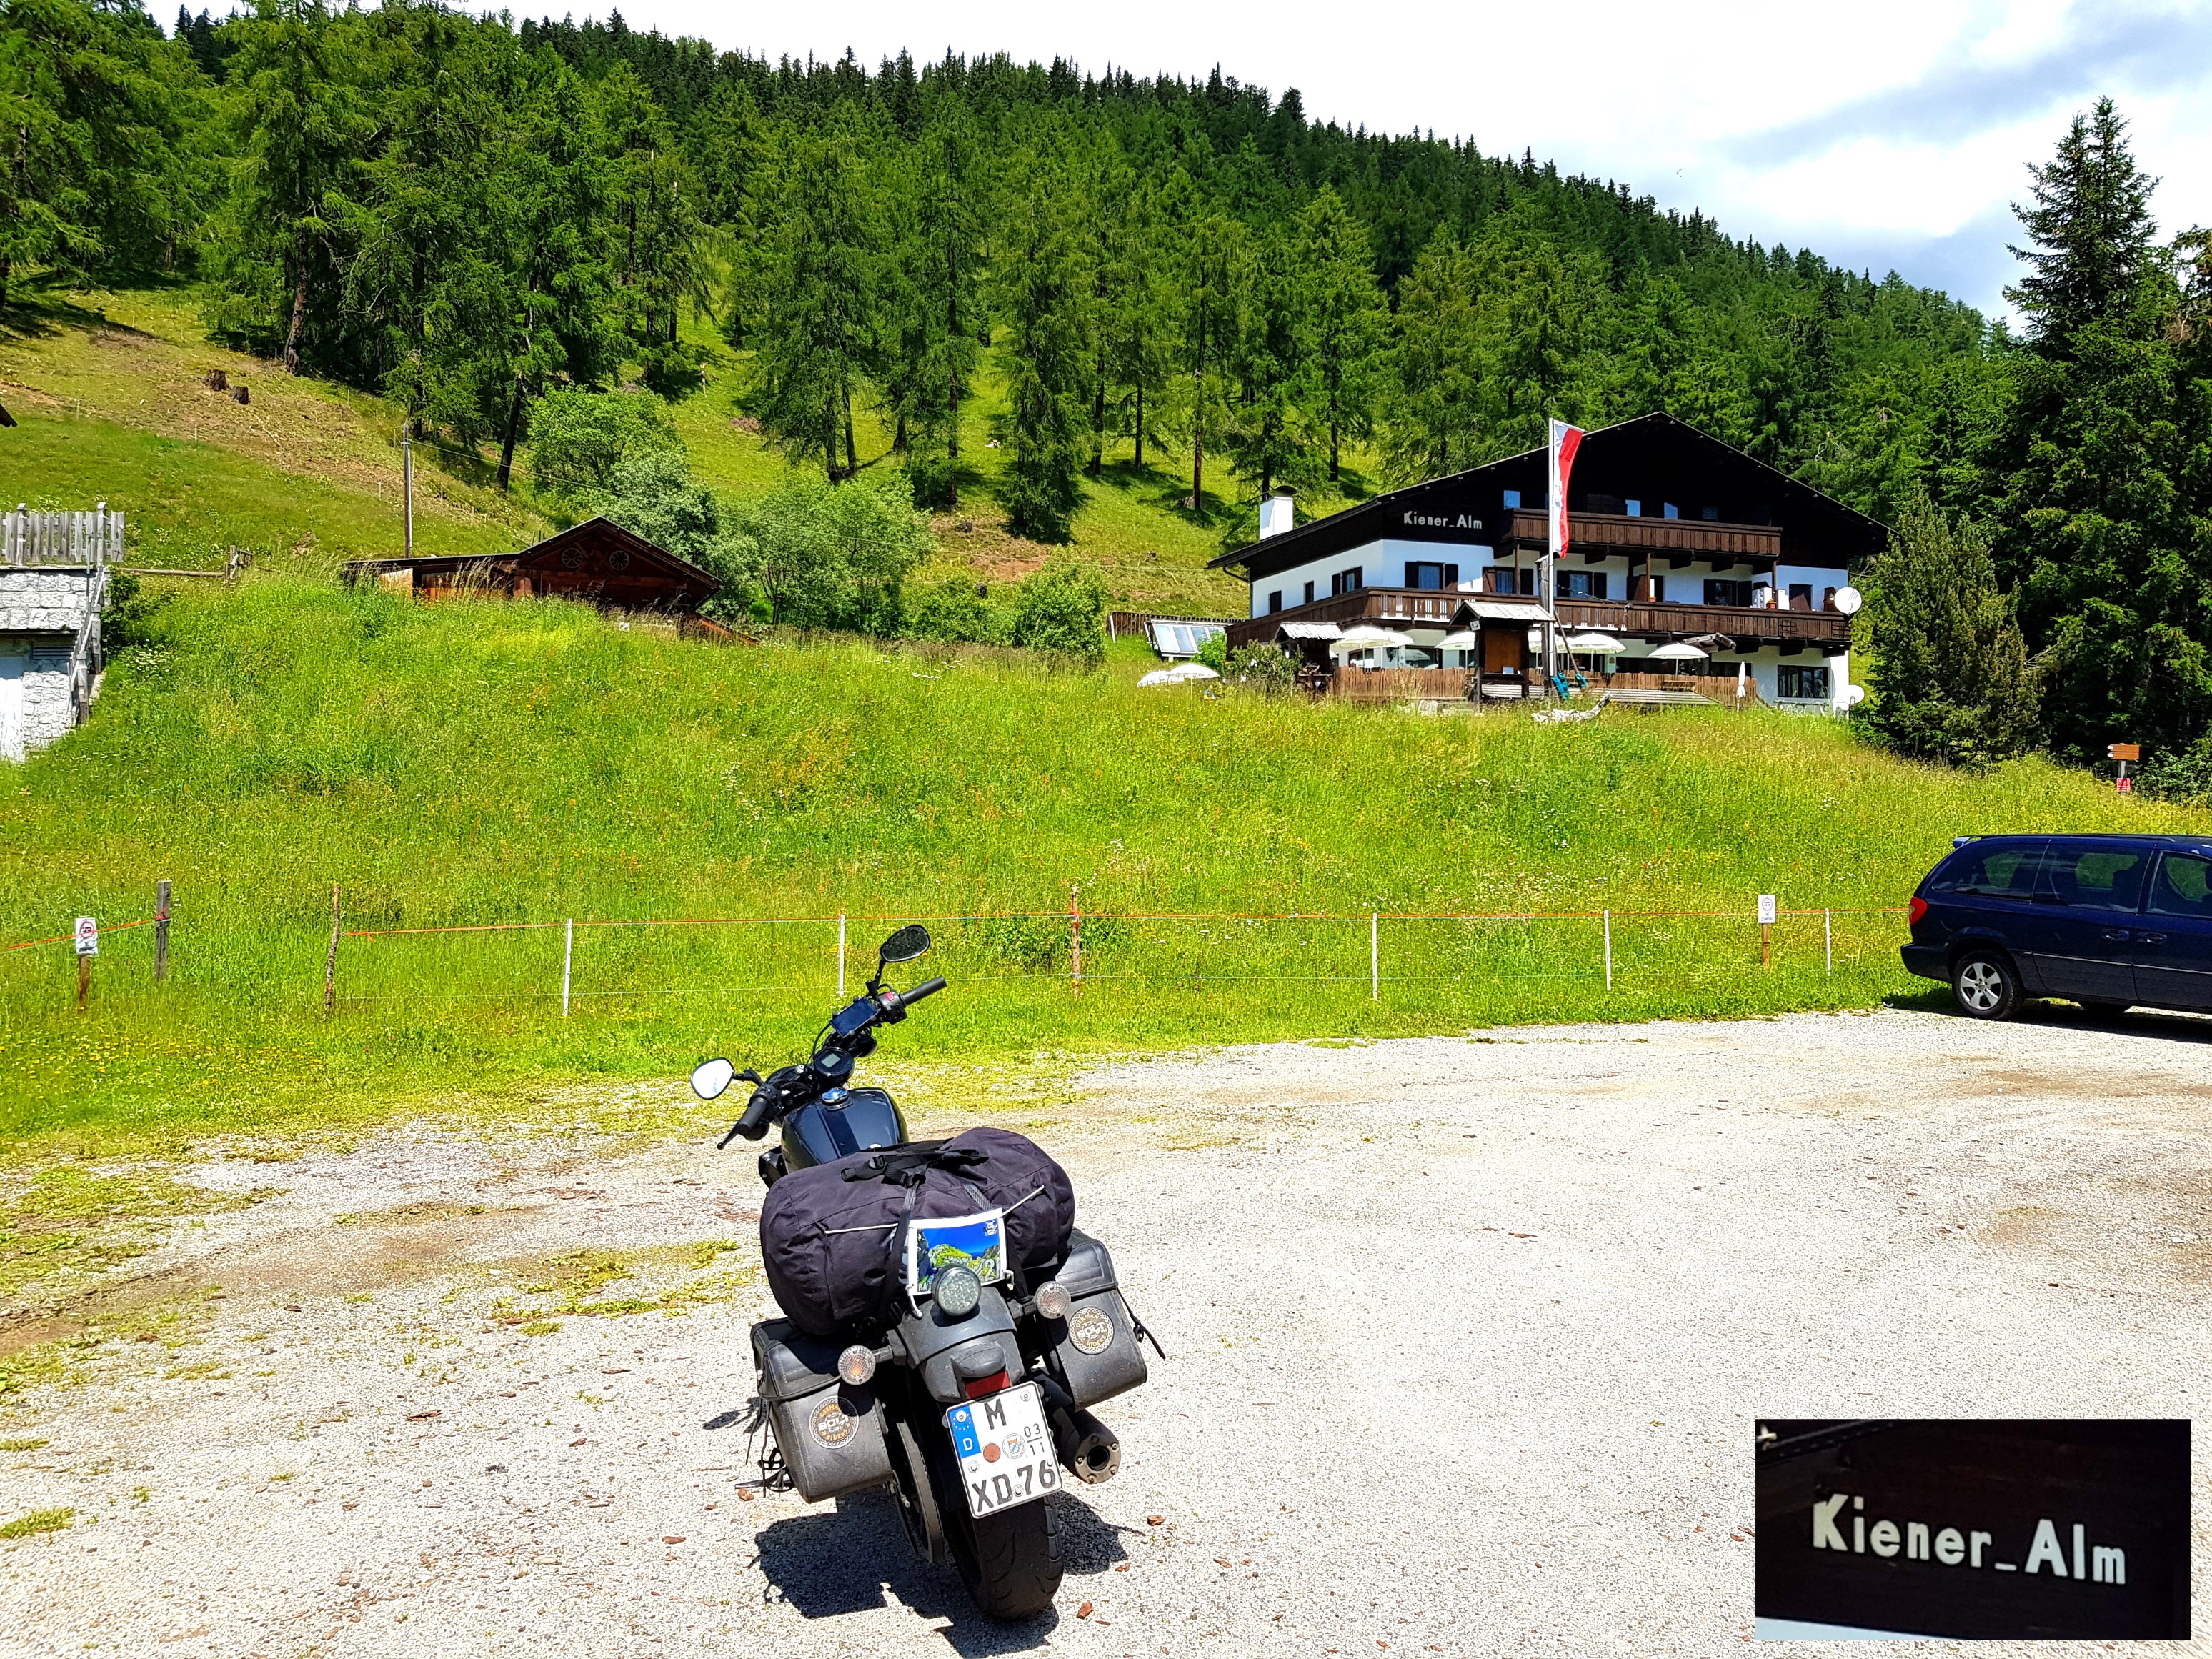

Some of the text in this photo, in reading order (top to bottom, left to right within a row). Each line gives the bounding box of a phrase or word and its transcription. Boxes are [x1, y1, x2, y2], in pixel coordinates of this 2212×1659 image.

[819, 1405, 840, 1418] GERMA
[984, 1398, 1007, 1430] M
[1024, 1423, 1041, 1438] 03
[963, 1438, 973, 1451] D
[1030, 1442, 1045, 1455] 11
